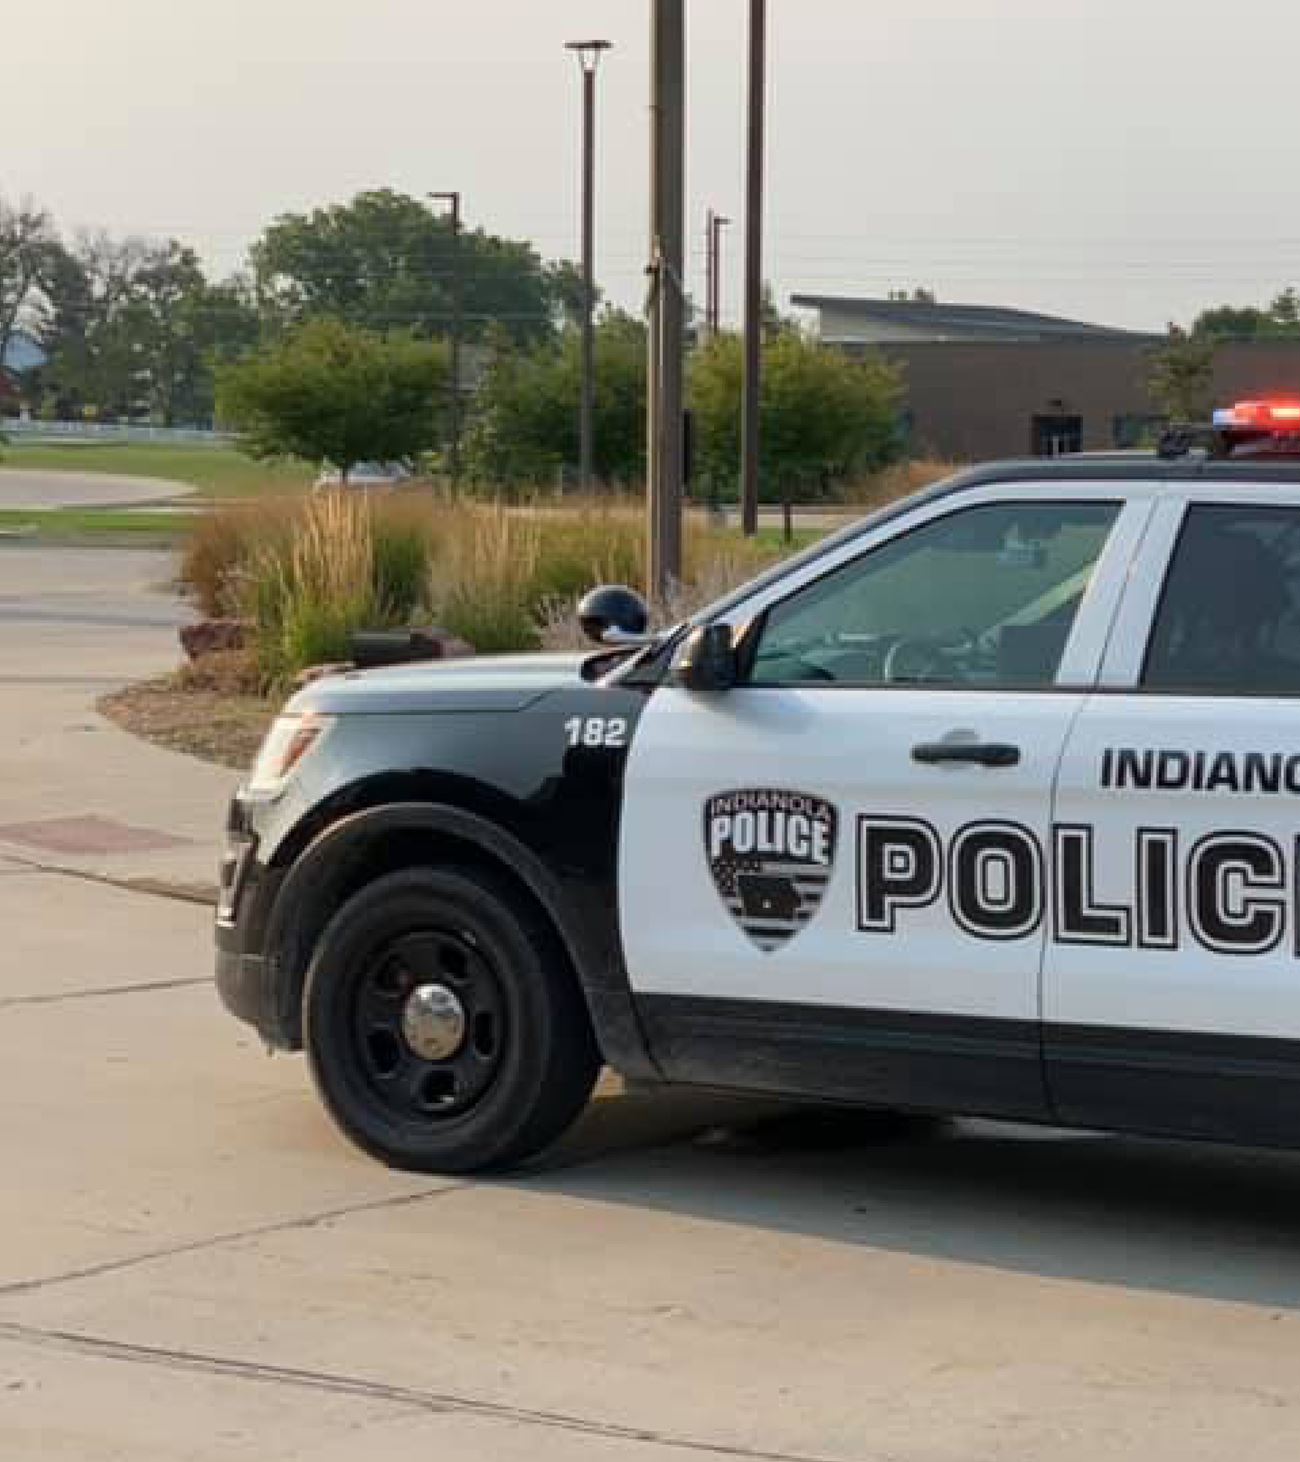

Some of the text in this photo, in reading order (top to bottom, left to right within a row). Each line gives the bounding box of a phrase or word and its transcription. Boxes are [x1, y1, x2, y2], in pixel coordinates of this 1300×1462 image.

[564, 715, 626, 746] 182
[711, 792, 832, 822] INDIANOLA
[711, 812, 832, 865] POLICE
